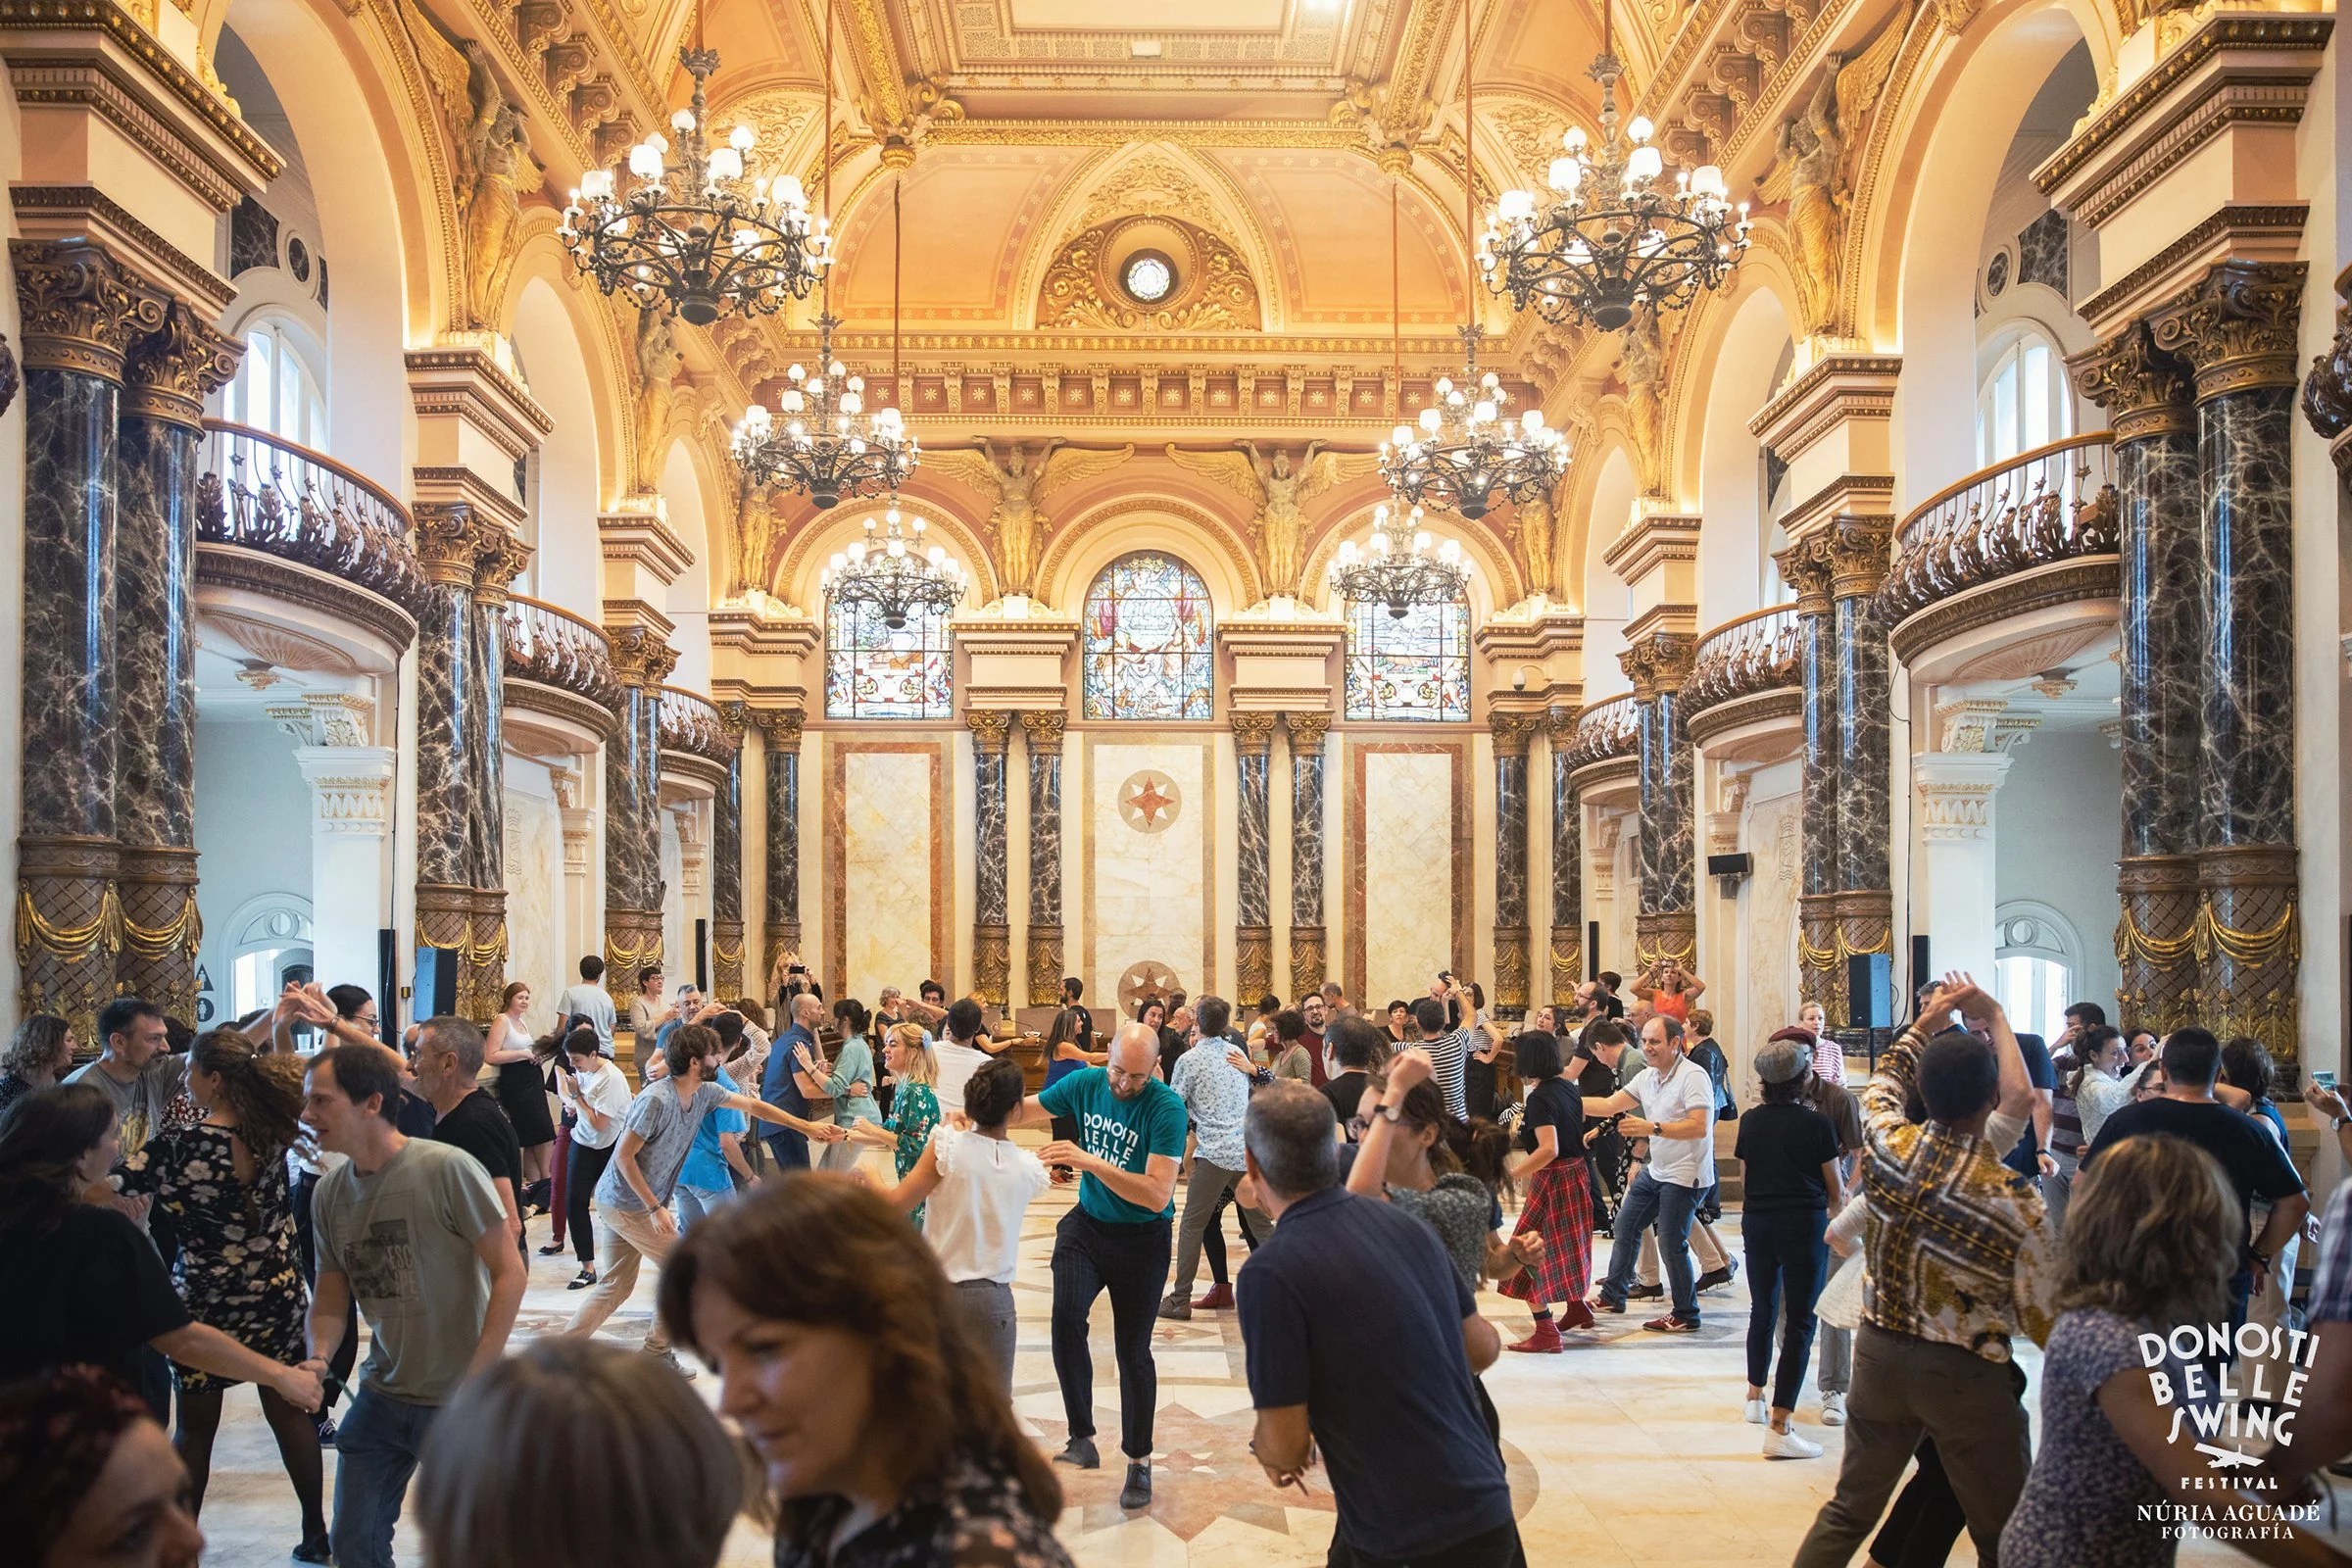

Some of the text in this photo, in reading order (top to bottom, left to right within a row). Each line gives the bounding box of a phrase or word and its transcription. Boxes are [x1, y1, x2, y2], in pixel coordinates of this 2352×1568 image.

[1084, 1112, 1139, 1148] DONOSTI
[1084, 1128, 1134, 1161] BELLE
[386, 1244, 414, 1270] ESC
